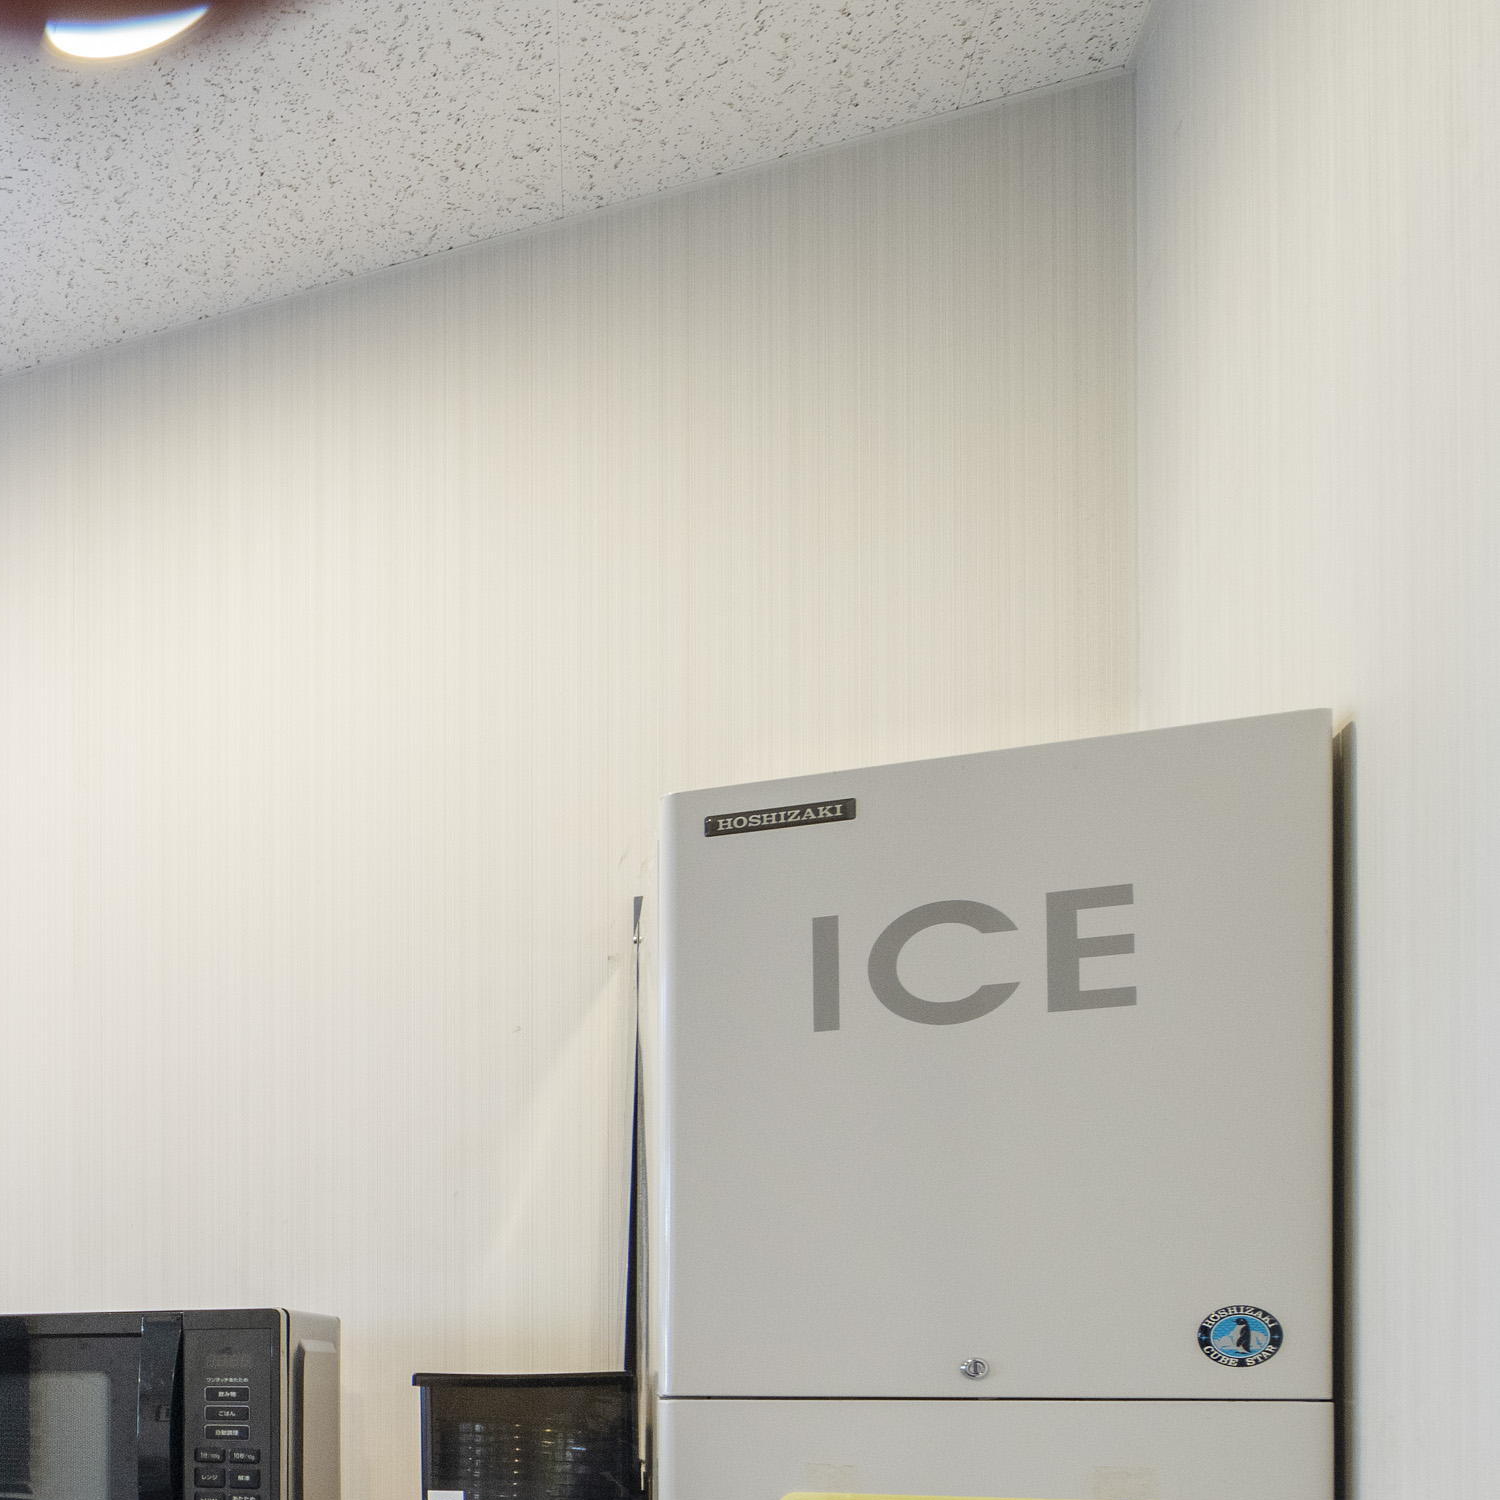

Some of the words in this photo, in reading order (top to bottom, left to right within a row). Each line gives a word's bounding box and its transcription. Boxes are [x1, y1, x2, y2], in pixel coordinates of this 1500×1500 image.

[717, 804, 843, 831] HOSHIZAKI
[812, 883, 1137, 1032] ICE
[1202, 1306, 1278, 1328] HOSHIZAKI
[1203, 1346, 1239, 1366] CUBE
[1246, 1344, 1277, 1366] STAR
